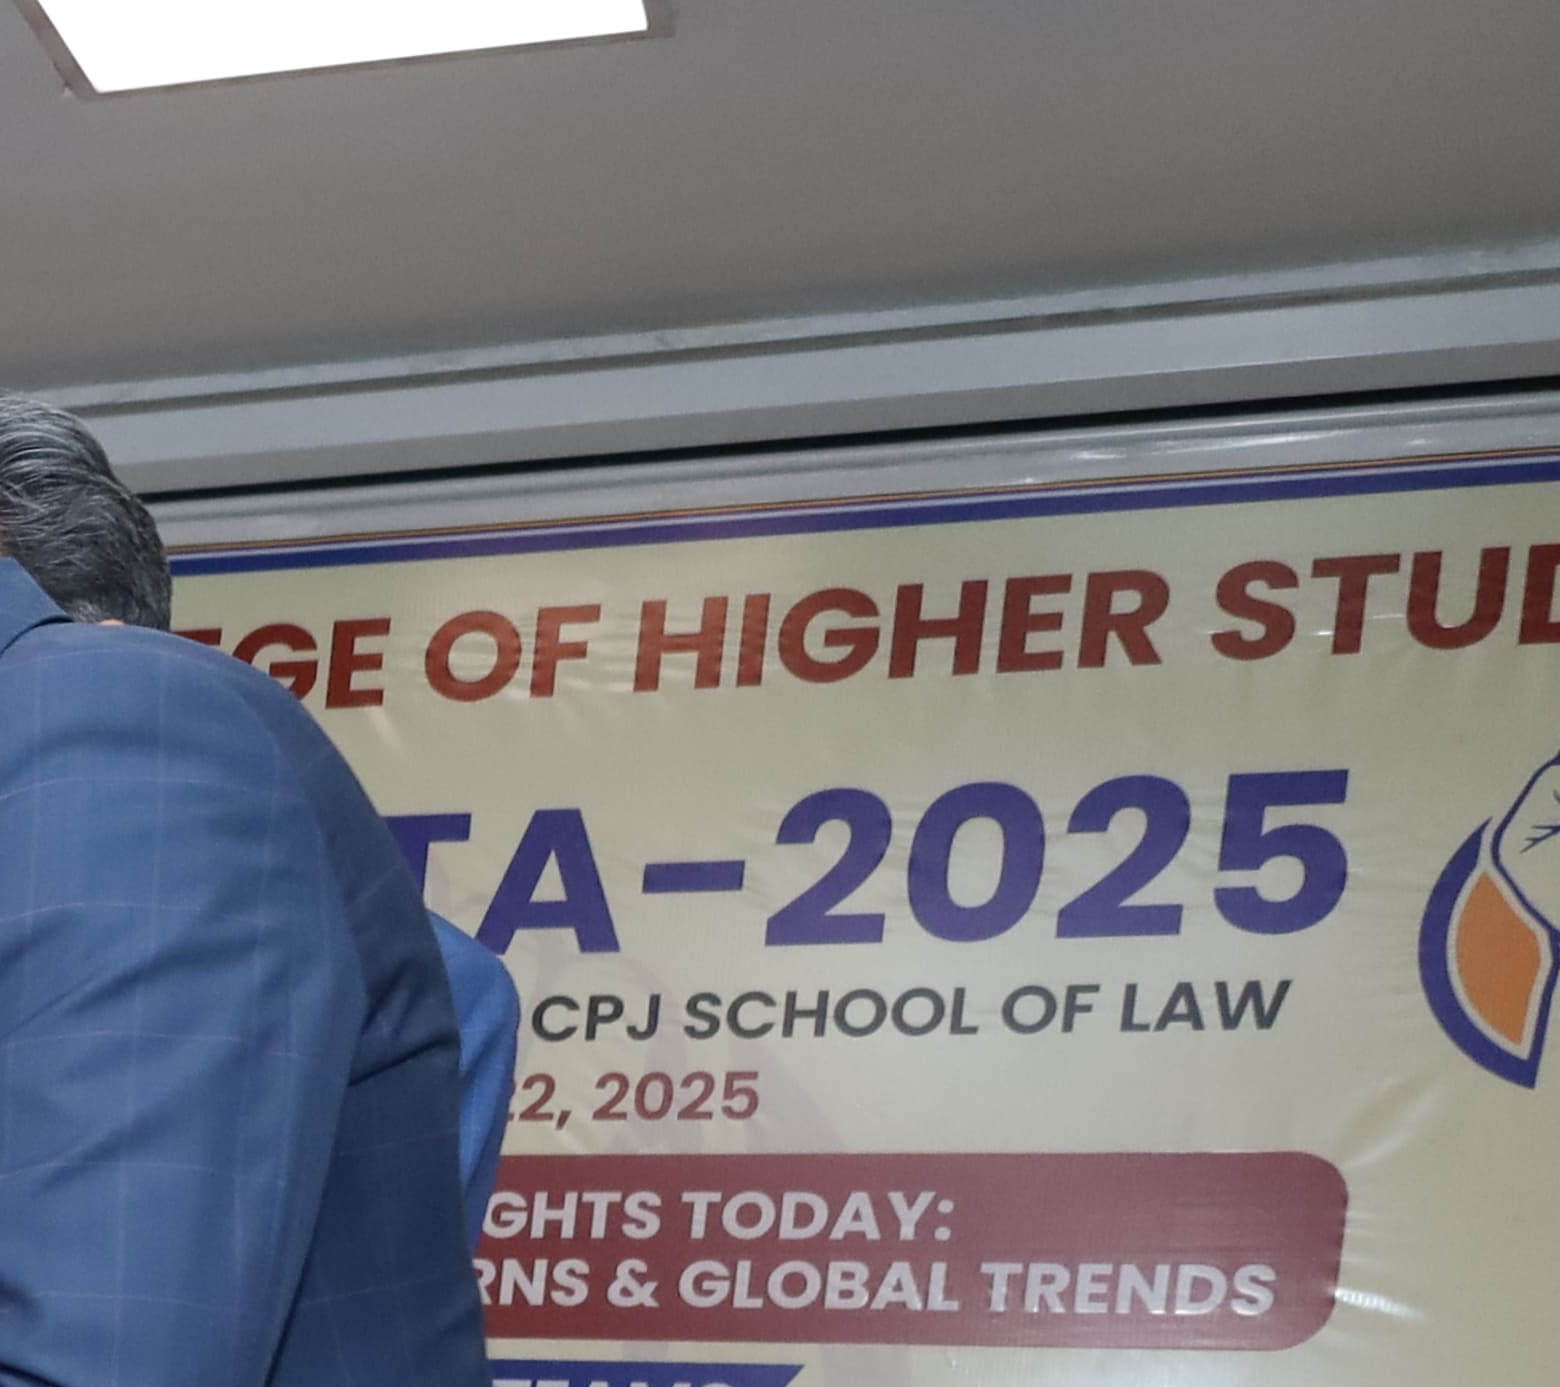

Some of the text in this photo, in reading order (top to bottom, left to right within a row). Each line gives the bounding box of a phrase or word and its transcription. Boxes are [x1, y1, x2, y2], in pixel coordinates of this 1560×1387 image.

[424, 603, 602, 702] OF
[633, 569, 1171, 693] HIGHER
[531, 979, 1292, 1043] CPJ SCHOOL OF LAW
[592, 1070, 760, 1122] 2025
[681, 1190, 955, 1243] TODAY:
[607, 1258, 660, 1309] &
[677, 1259, 960, 1312] GLOBAL
[980, 1262, 1278, 1317] TRENDS
